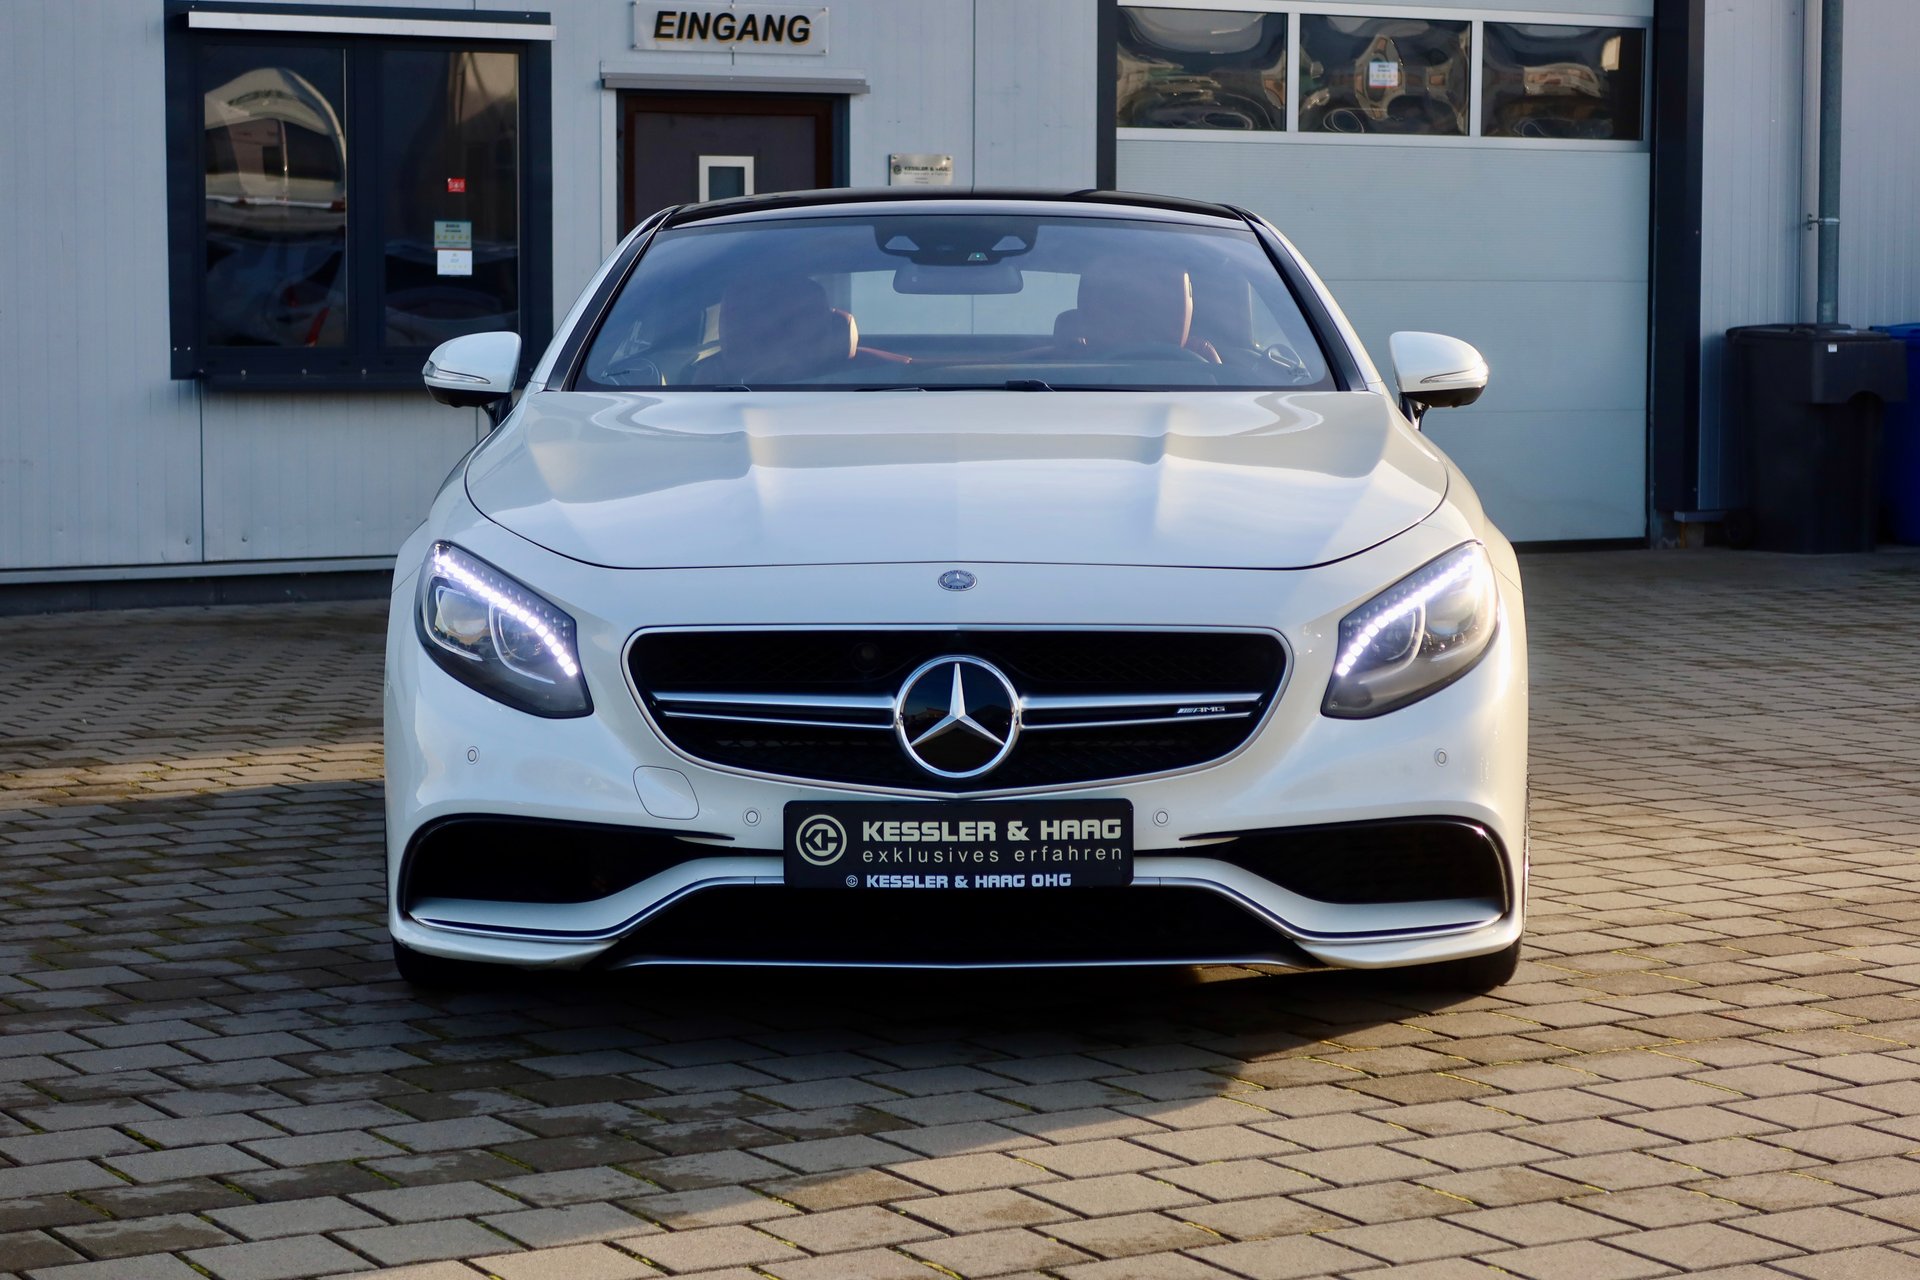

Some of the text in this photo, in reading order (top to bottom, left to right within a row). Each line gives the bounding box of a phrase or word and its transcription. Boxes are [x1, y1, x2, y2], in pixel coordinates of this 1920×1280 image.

[653, 10, 812, 44] EINGANG
[862, 819, 1122, 842] KESSLER & HAAG
[862, 846, 1122, 863] exklusives erfahren
[866, 873, 1072, 888] KESSLER & HAAG OHG
